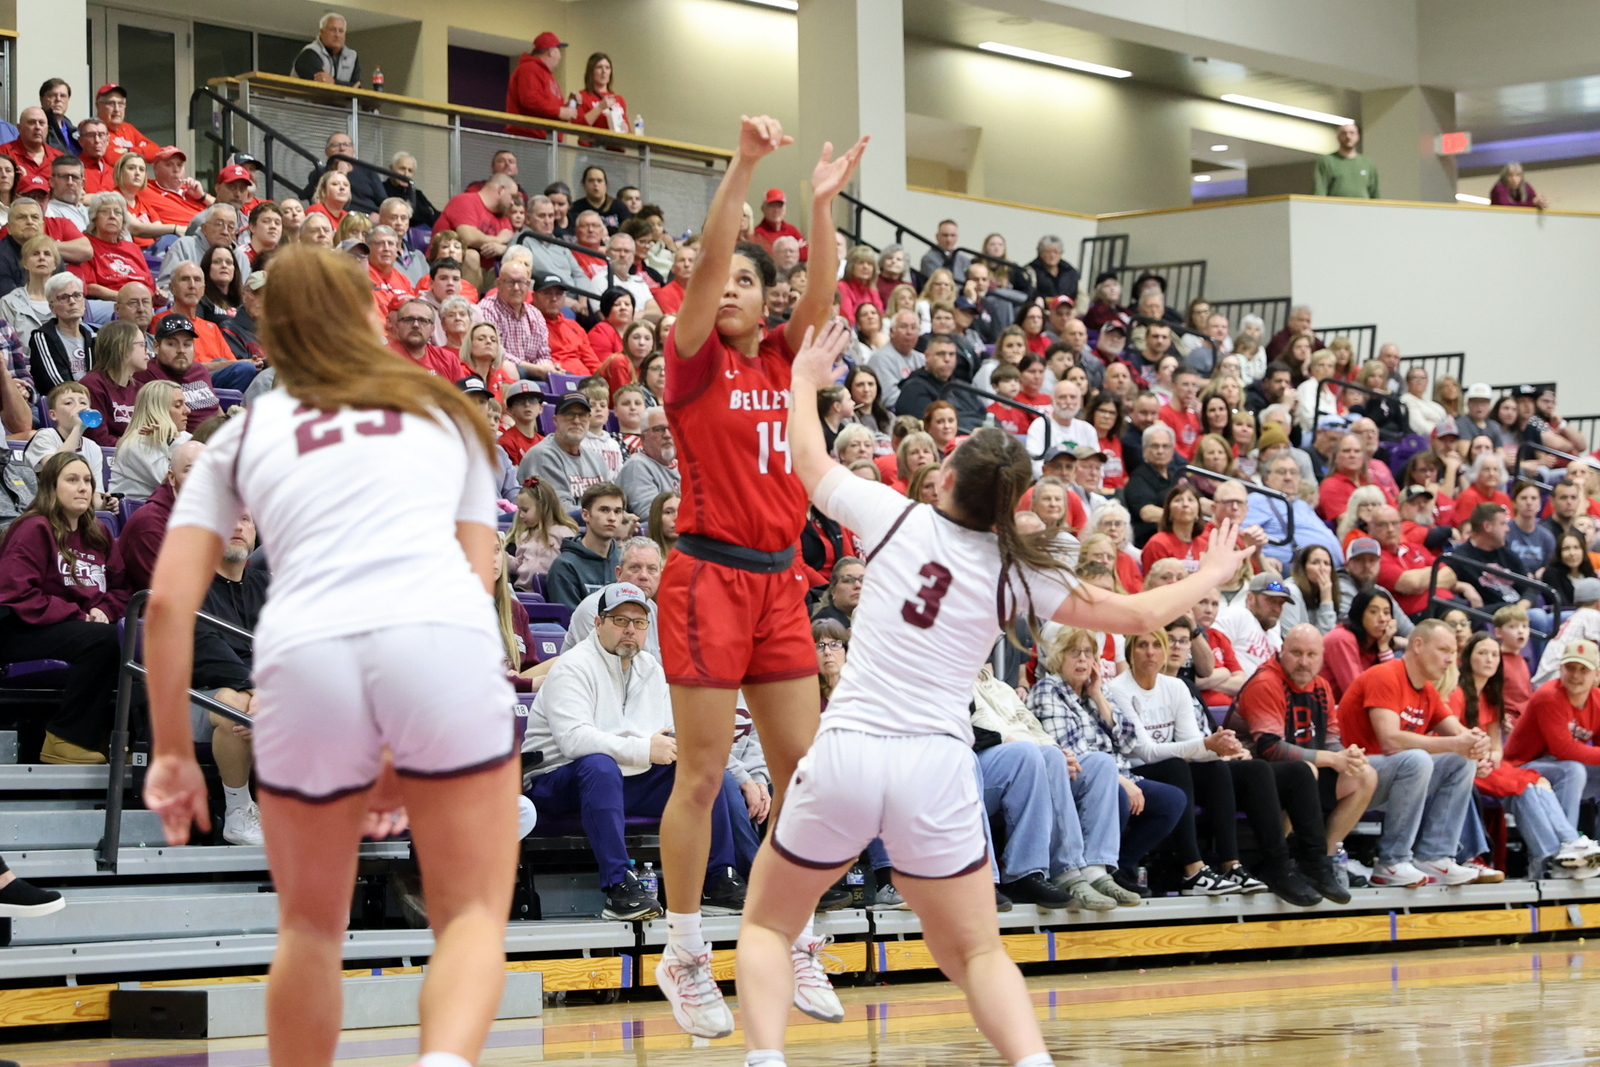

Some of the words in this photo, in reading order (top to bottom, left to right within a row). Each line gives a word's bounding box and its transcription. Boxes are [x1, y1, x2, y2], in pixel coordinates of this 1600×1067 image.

[73, 348, 86, 359] G
[182, 387, 215, 402] OMETS
[756, 421, 792, 475] 14
[901, 561, 952, 629] 3
[545, 643, 554, 652] 20
[517, 706, 526, 715] 18
[137, 755, 142, 764] B
